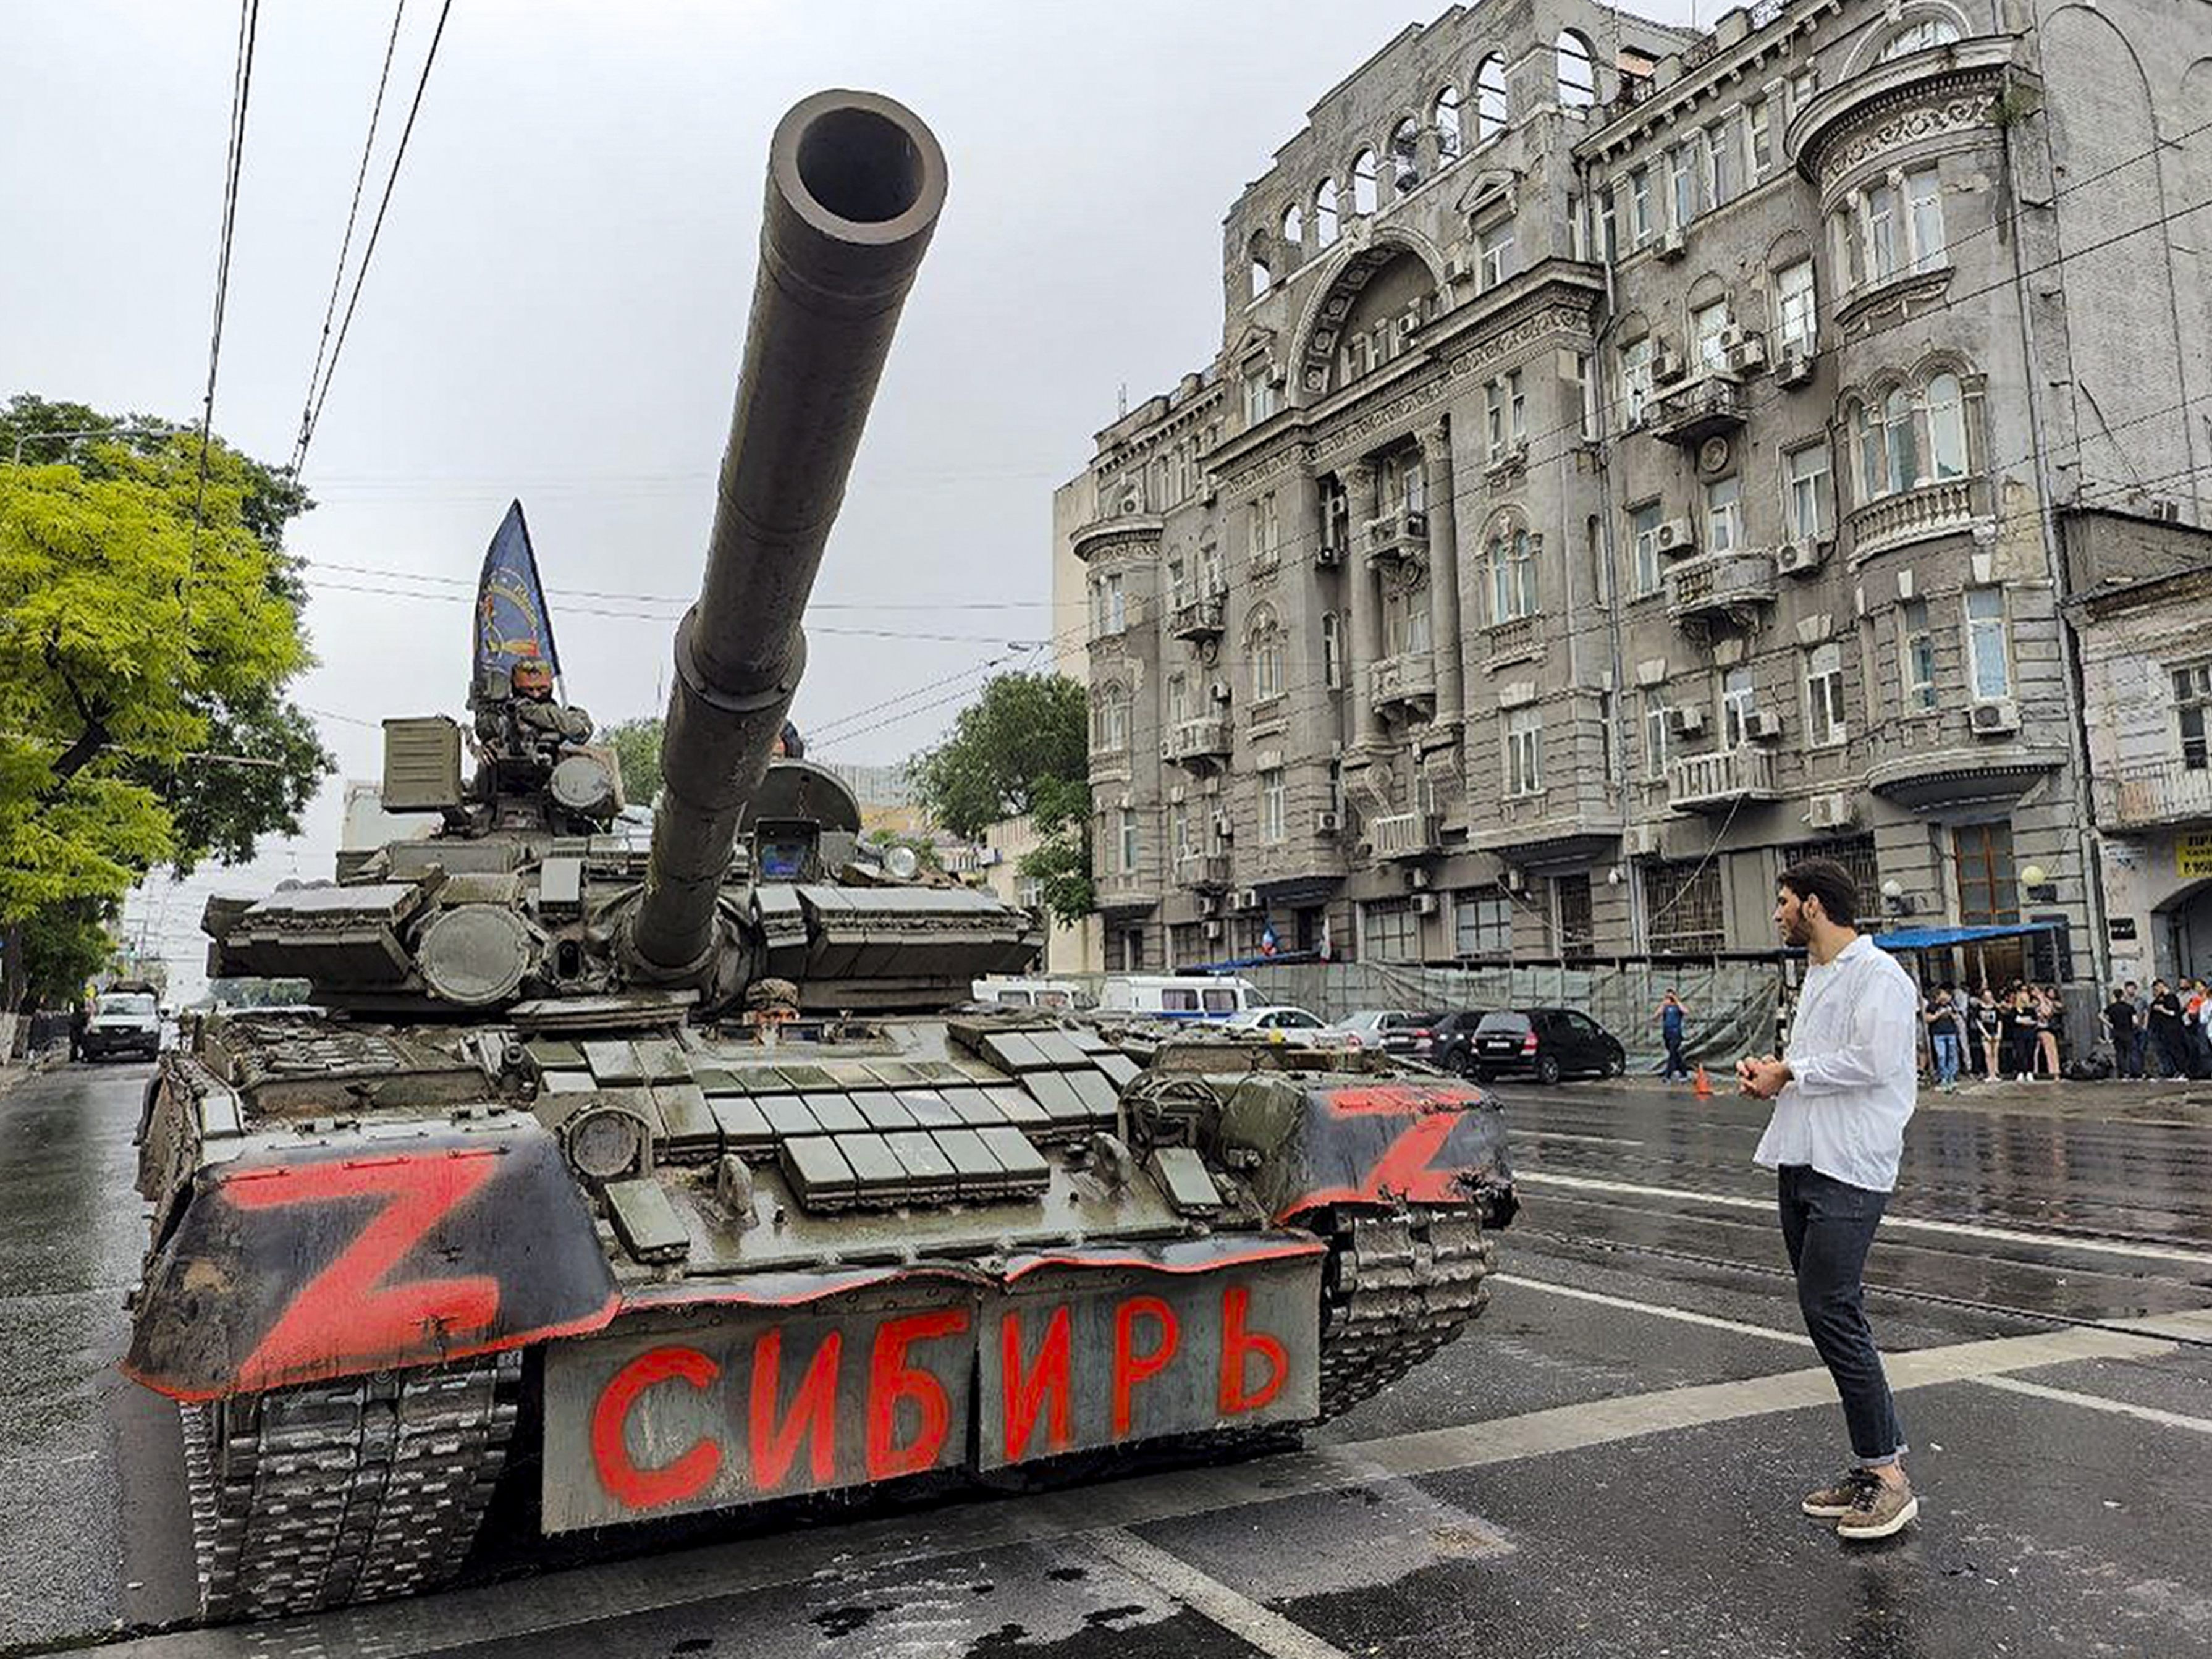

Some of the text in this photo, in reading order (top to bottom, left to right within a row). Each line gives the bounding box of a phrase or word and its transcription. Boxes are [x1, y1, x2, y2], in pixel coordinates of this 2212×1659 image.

[1328, 1086, 1480, 1201] Z
[221, 1151, 500, 1389] Z
[590, 1288, 1290, 1508] СИБИРЬ
